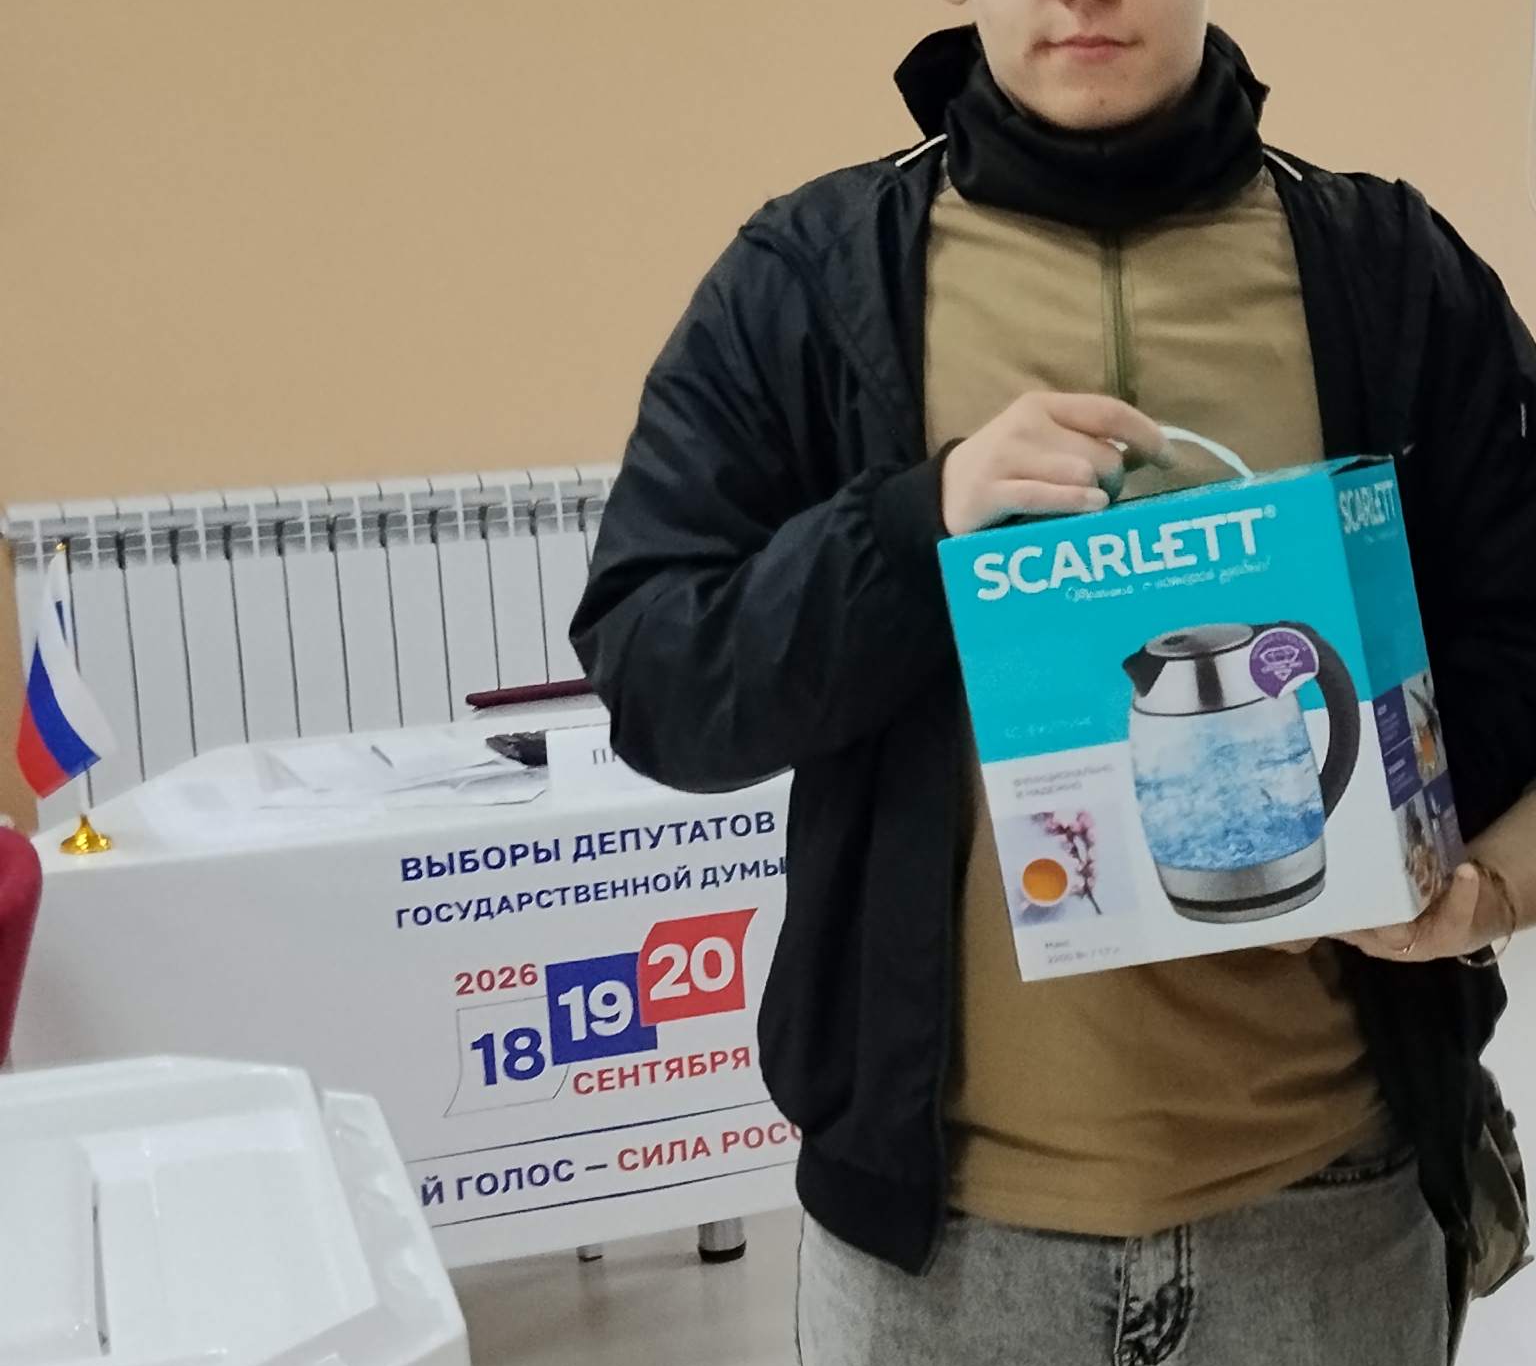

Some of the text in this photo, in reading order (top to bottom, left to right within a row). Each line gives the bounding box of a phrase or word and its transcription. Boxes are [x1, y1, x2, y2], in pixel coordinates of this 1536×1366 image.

[973, 507, 1264, 602] SCARLETT
[401, 810, 776, 883] ВЫБОРЫ ДЕПУТАТОВ
[396, 856, 787, 929] ГОСУДАРСТВЕННОЙ ДУМЫ
[455, 963, 539, 997] 2026
[470, 935, 736, 1087] 18 19 20
[572, 1045, 752, 1097] СЕНТЯБРЯ
[456, 1158, 575, 1202] ГОЛОС
[617, 1130, 712, 1174] СИЛА
